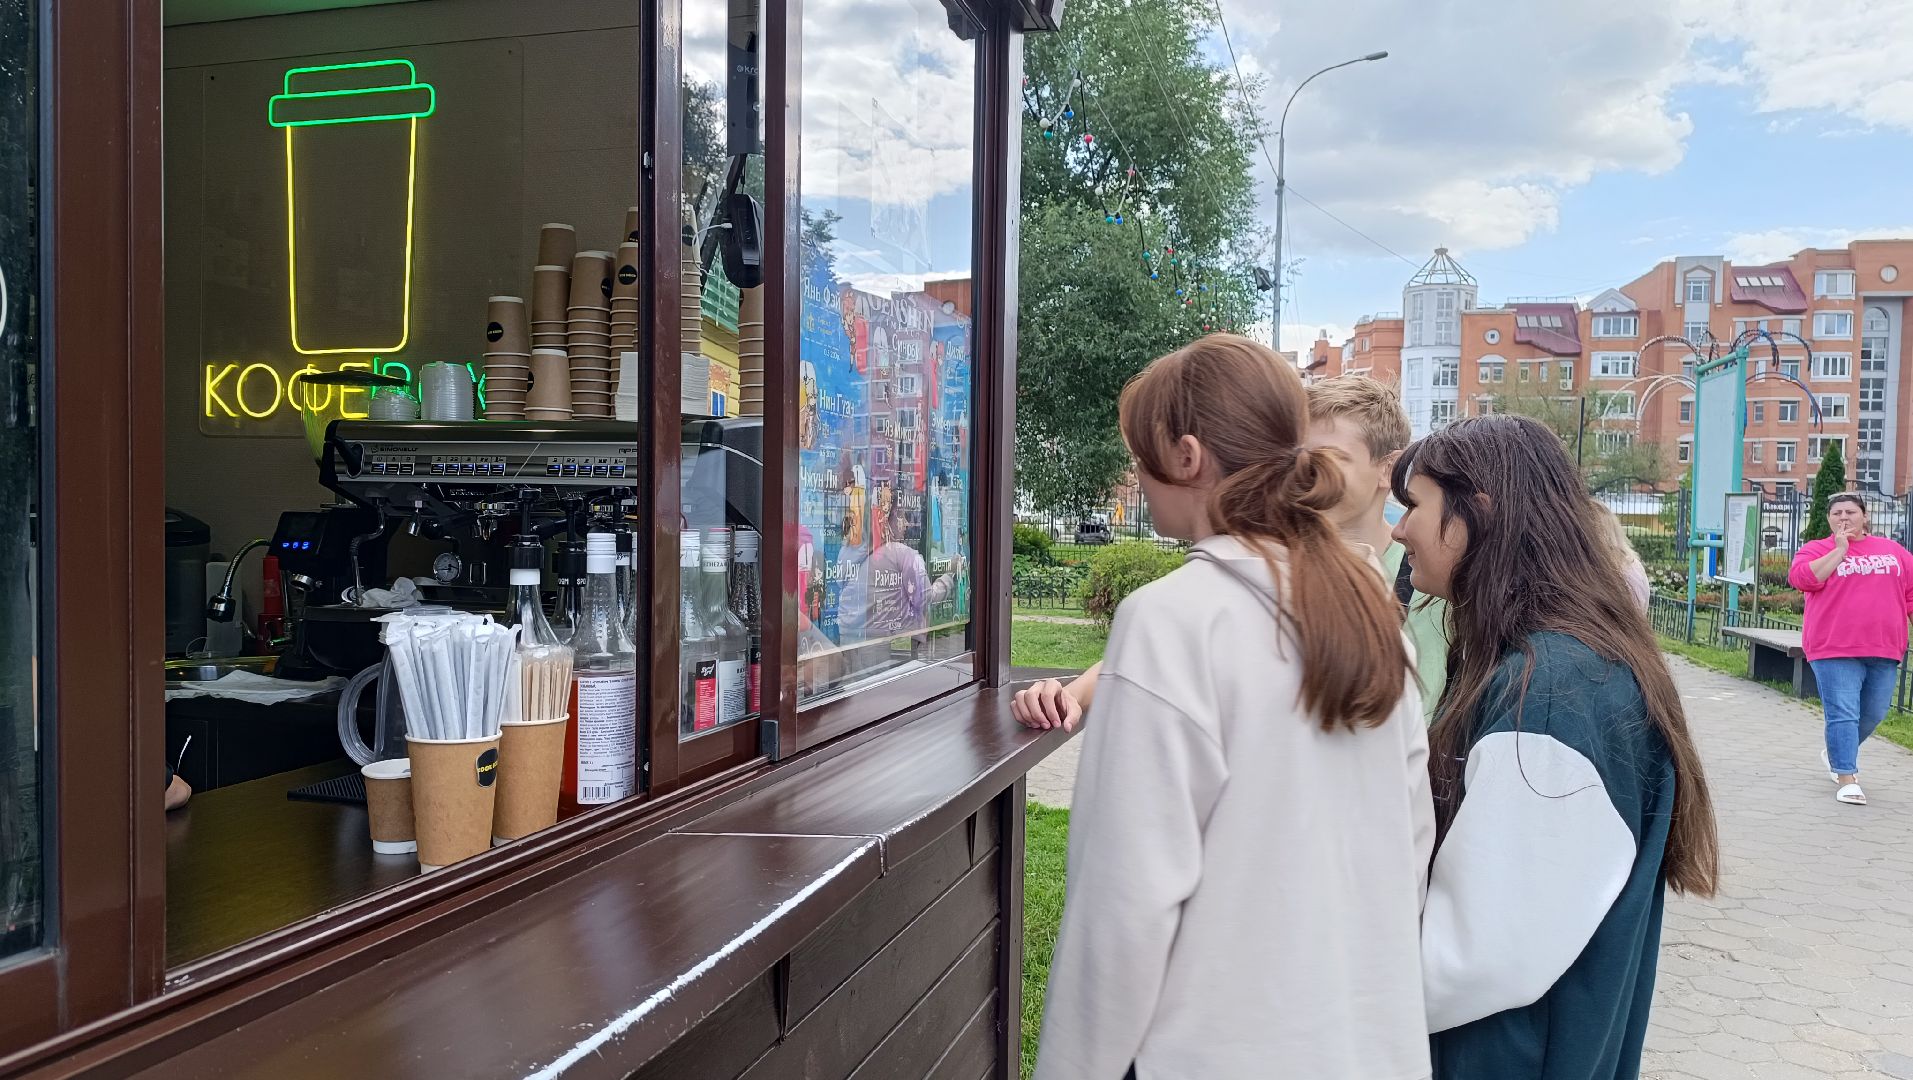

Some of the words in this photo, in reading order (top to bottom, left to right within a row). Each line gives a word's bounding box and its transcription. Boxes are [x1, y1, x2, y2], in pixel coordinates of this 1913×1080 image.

[803, 277, 821, 302] Янь
[823, 284, 841, 311] Фэй
[205, 362, 369, 418] КОФЕ
[819, 388, 836, 411] Нин
[800, 466, 823, 492] Чжун
[825, 469, 838, 489] Ли
[825, 559, 843, 580] Бей
[845, 560, 860, 582] Доу
[874, 569, 903, 588] Райдэн
